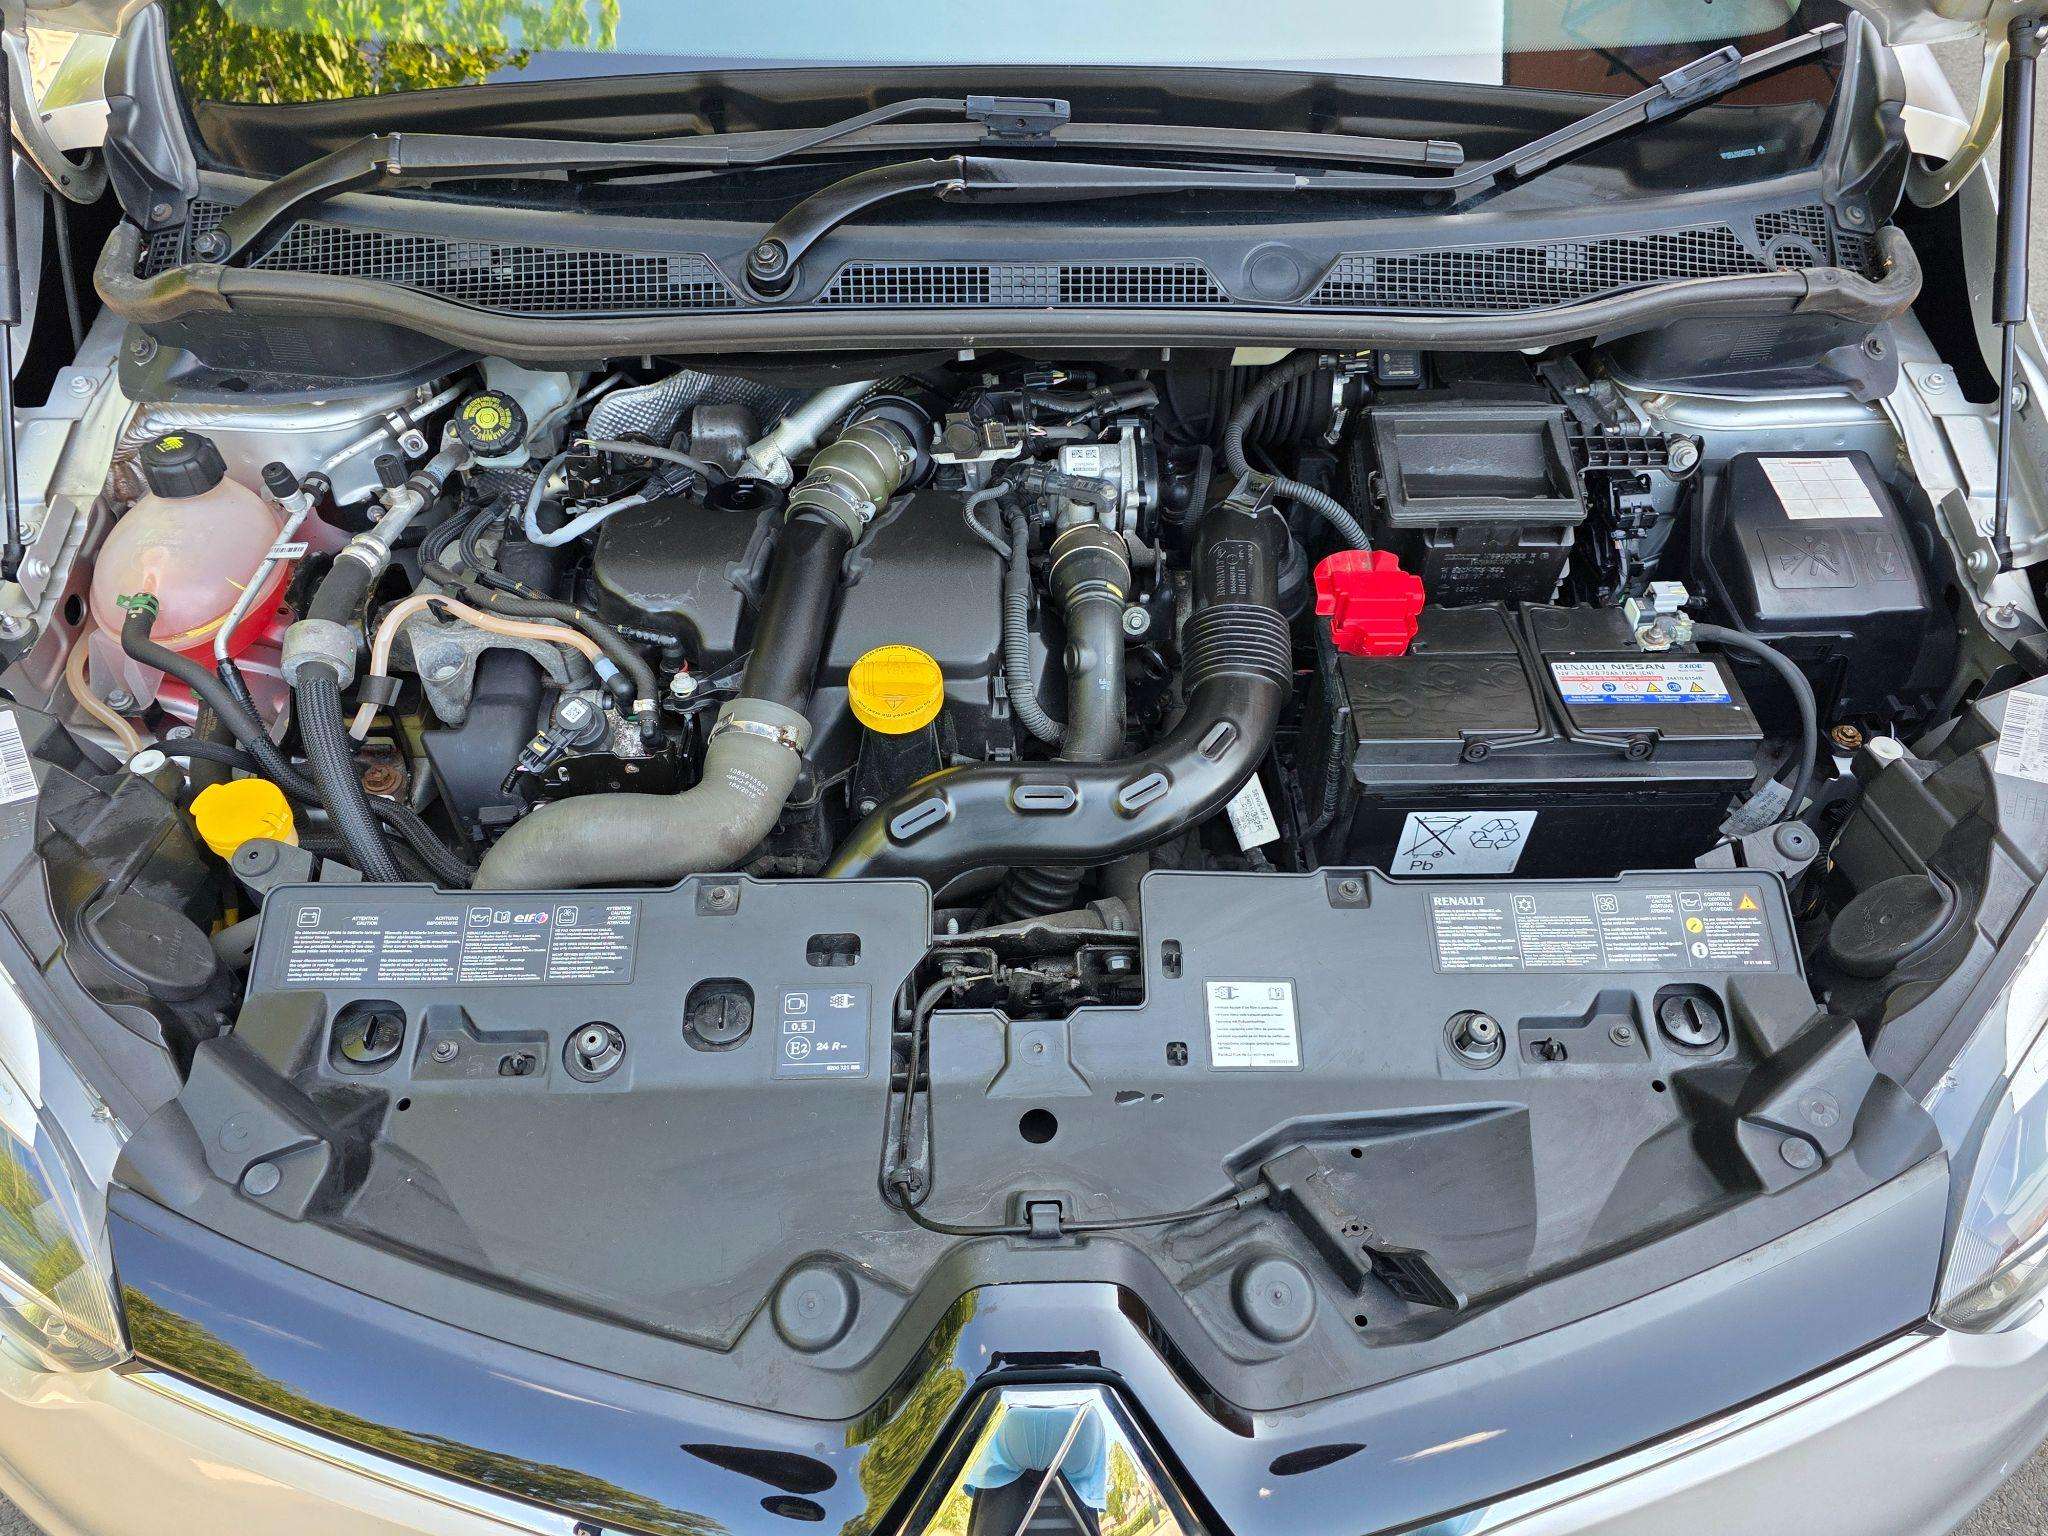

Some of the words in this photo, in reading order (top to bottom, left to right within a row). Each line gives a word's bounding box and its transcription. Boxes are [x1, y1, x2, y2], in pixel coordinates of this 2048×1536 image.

[1409, 860, 1434, 871] Pb
[1434, 896, 1486, 906] RENAULT
[513, 913, 536, 923] elf
[816, 1041, 829, 1051] 24
